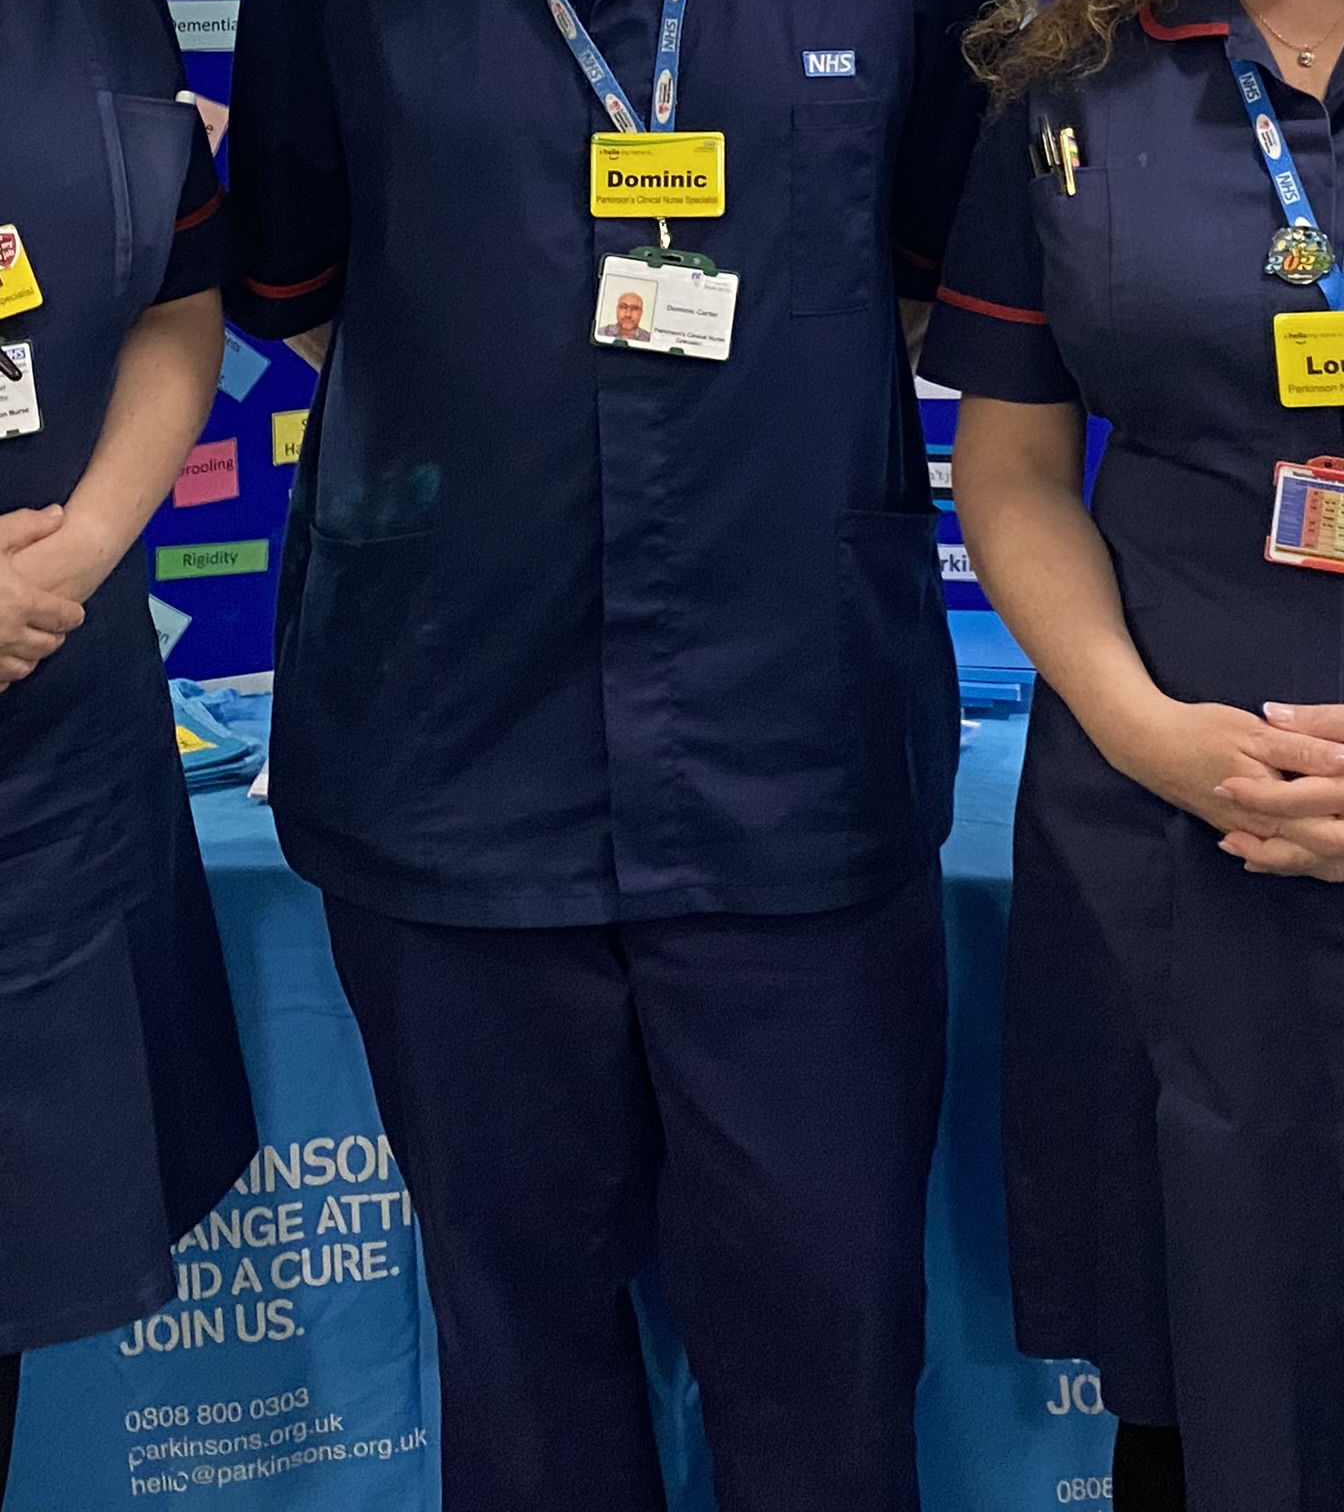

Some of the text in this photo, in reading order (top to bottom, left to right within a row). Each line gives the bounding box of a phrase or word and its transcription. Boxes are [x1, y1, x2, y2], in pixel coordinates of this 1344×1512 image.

[808, 53, 853, 73] NHS
[607, 170, 708, 188] Dominic
[1277, 173, 1298, 202] NHS
[182, 550, 238, 569] Rigidity
[232, 1257, 262, 1295] A
[271, 1241, 400, 1286] CURE.
[120, 1299, 305, 1357] JOIN US.
[125, 1388, 308, 1433] 0808 800 0303
[128, 1413, 343, 1471] parkinsons.org.uk
[131, 1427, 427, 1496] hello@parkinsons.org.uk
